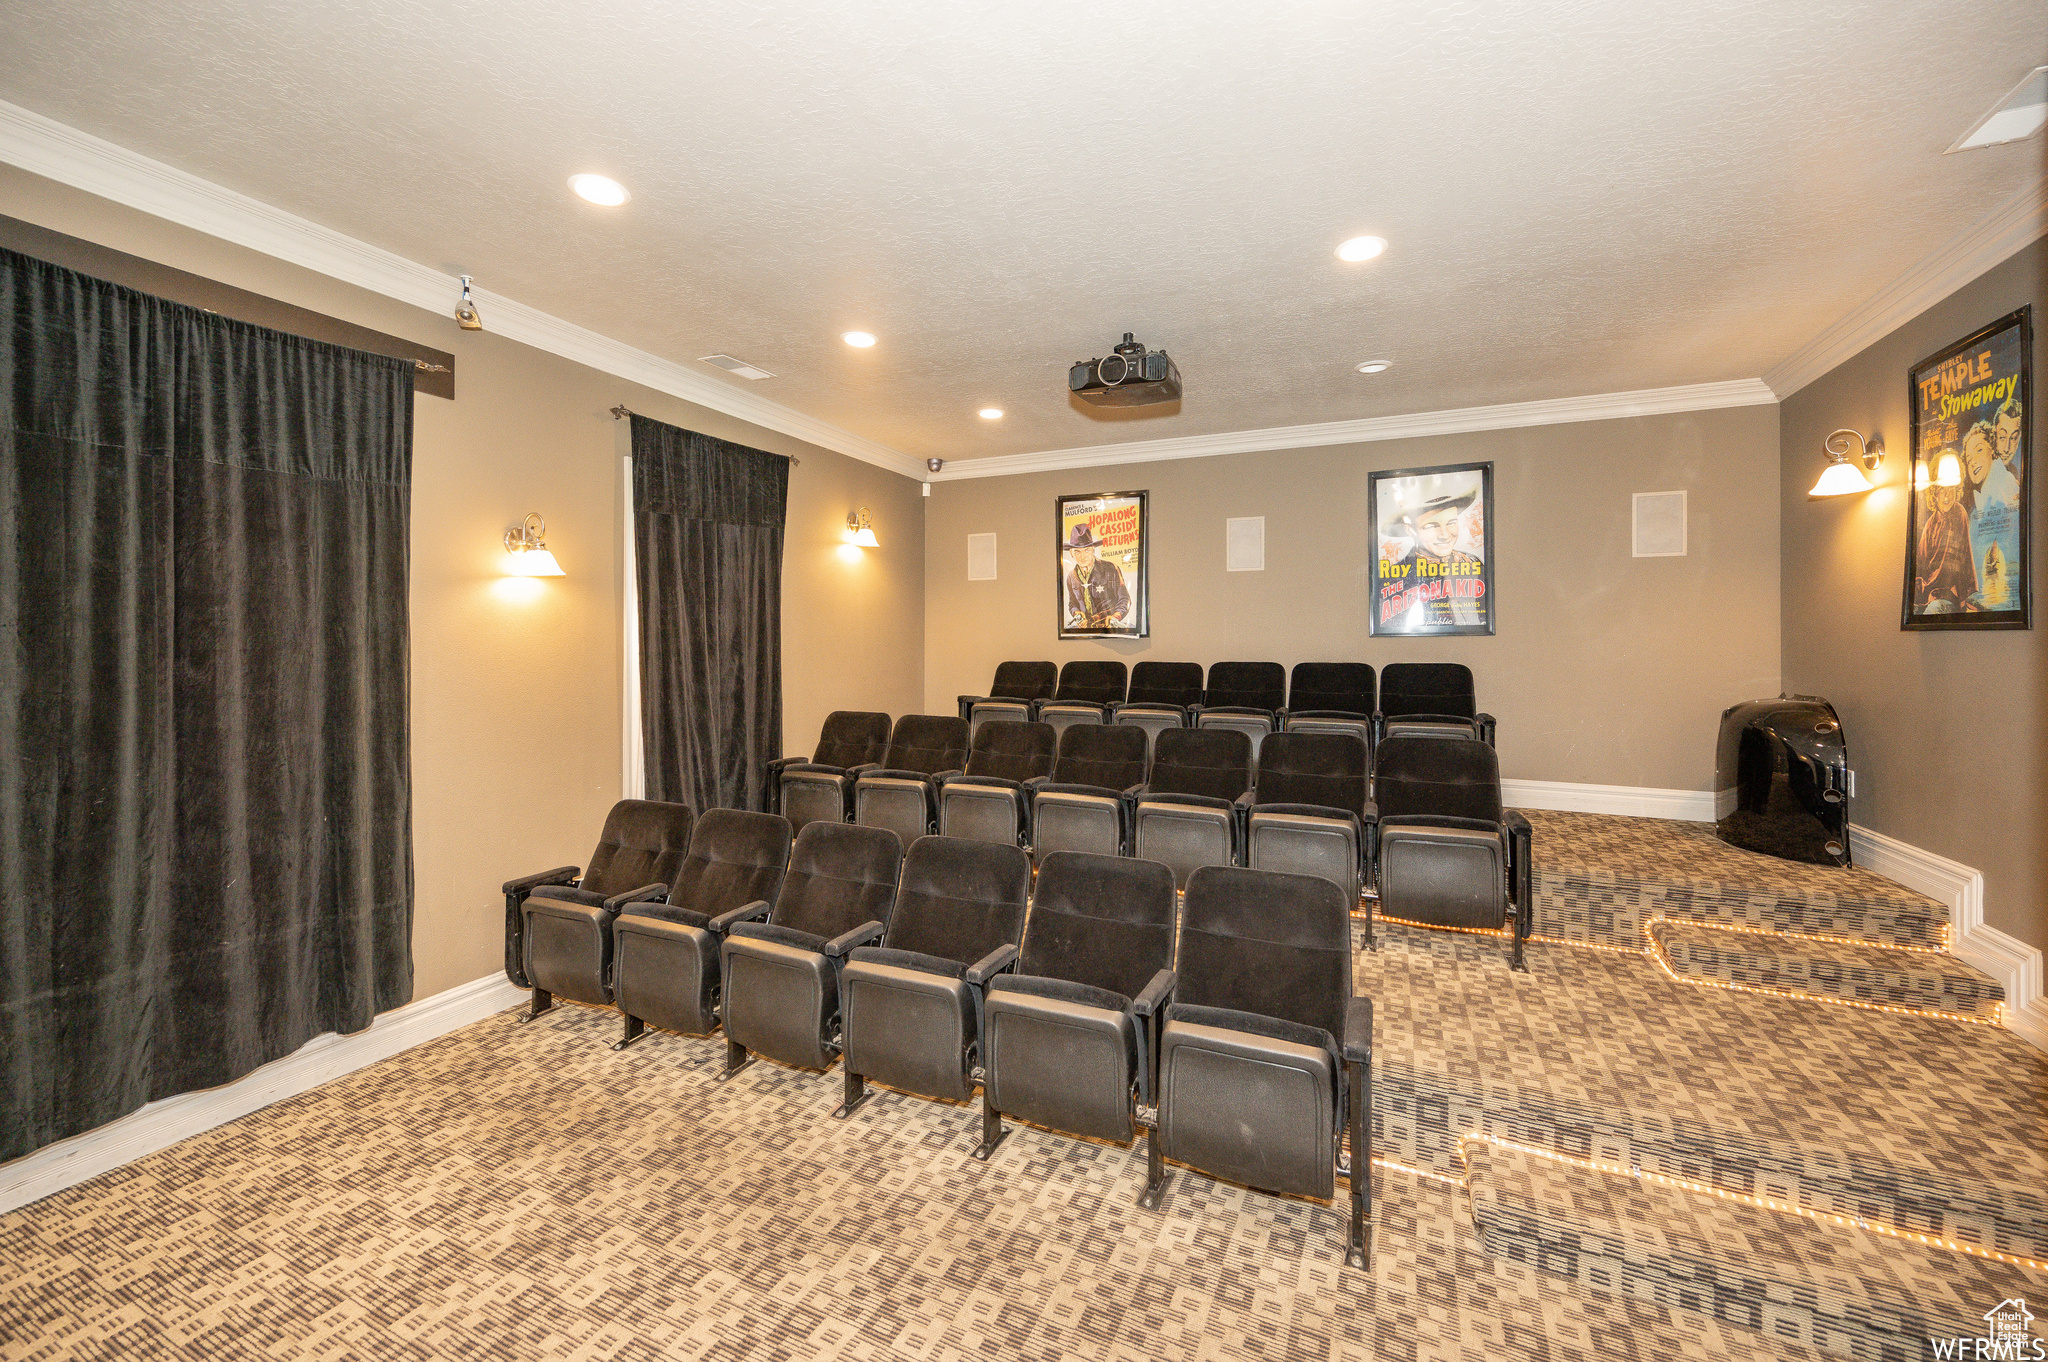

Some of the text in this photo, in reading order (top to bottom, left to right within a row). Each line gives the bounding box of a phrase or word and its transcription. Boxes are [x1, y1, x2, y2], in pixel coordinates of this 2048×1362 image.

[1938, 354, 1963, 373] SHIRLEY
[1920, 350, 1993, 410] TEMPLE
[1938, 374, 2018, 420] Stowaway
[1086, 505, 1137, 531] HOPALONG
[1100, 518, 1137, 536] CASSIDY
[1102, 529, 1139, 547] RETURNS
[1416, 558, 1482, 577] ROGERS
[1381, 580, 1404, 599] THE
[1380, 579, 1486, 624] ARIZONA KID
